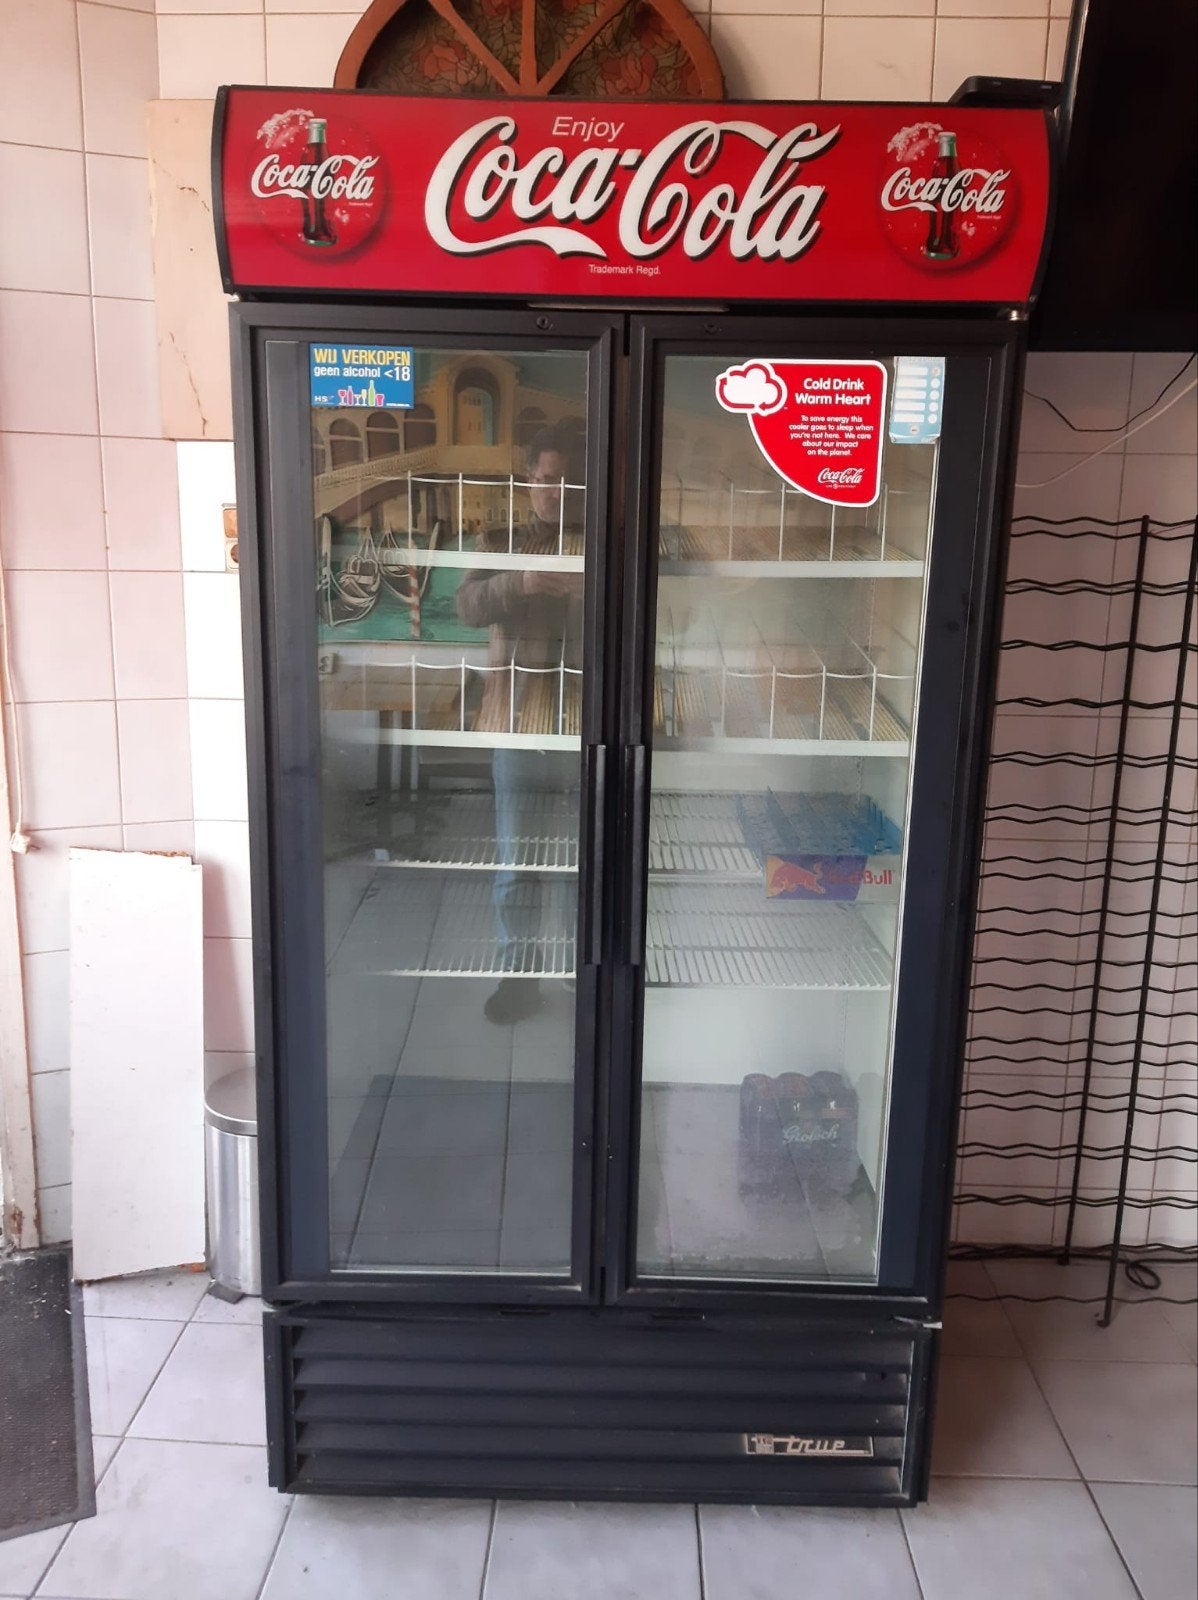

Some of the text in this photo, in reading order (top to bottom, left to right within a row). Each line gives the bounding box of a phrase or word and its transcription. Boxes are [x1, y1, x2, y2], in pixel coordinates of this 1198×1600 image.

[552, 116, 625, 143] Enjoy
[251, 153, 380, 200] Coca-Cola
[424, 115, 842, 260] Coca-Cola
[881, 166, 1012, 213] Coca-Cola
[588, 263, 661, 277] Trademark Regd.
[314, 348, 411, 366] WIJ VERKOPEN
[314, 366, 411, 381] geen alcohol <18
[803, 377, 865, 390] Cold Drink
[795, 392, 872, 405] Warm Heart
[826, 416, 850, 424] energy
[836, 440, 859, 448] impact
[818, 467, 865, 484] Coca-Cola
[863, 869, 892, 884] Bull
[786, 1435, 846, 1453] true
